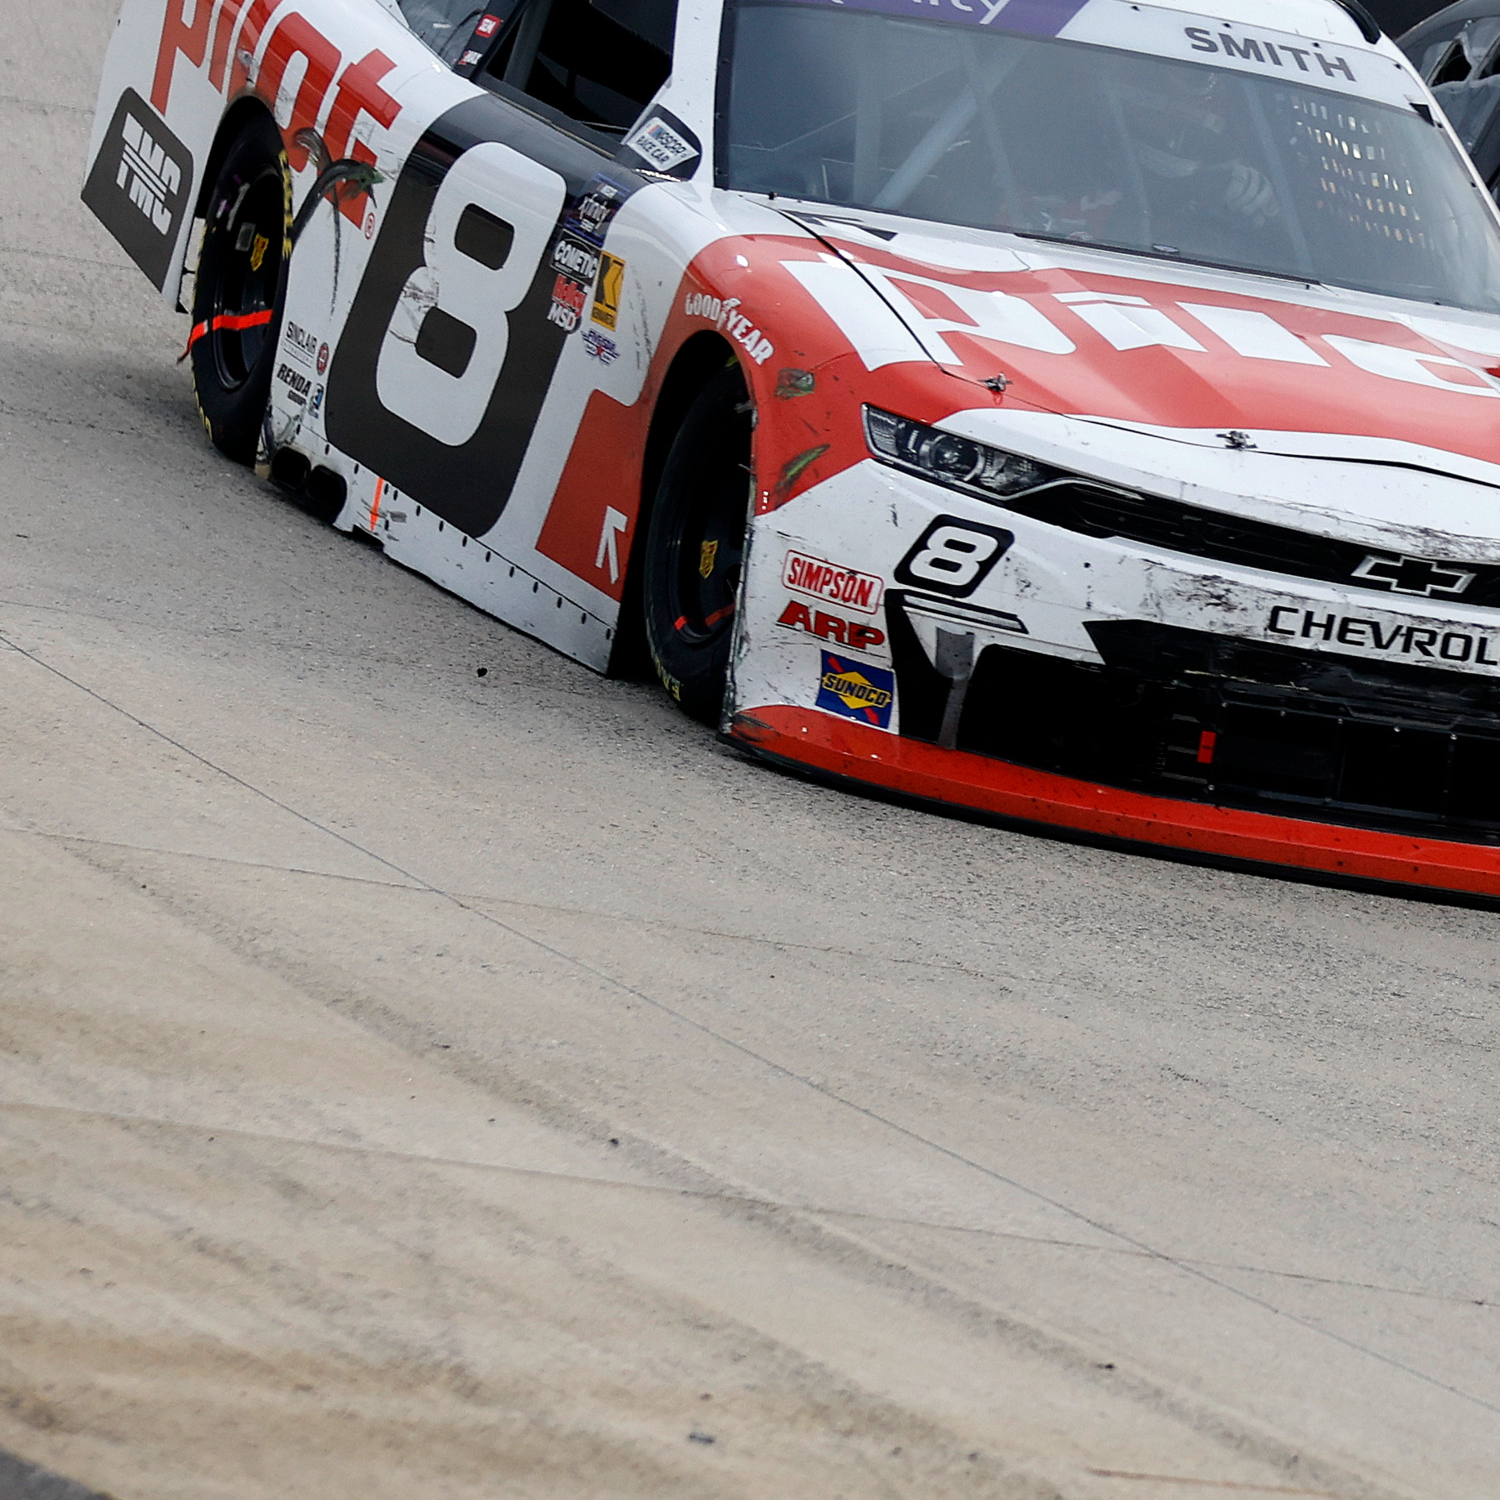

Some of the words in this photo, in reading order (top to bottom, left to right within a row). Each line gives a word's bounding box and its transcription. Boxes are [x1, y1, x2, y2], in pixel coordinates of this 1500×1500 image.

[1183, 26, 1358, 83] SMITH
[376, 141, 567, 446] 8
[547, 303, 578, 331] MSD
[276, 362, 312, 397] RENDA
[908, 525, 999, 587] 8
[786, 556, 876, 609] SIMPSON
[776, 600, 886, 650] ARP
[823, 674, 890, 707] SUNOCO
